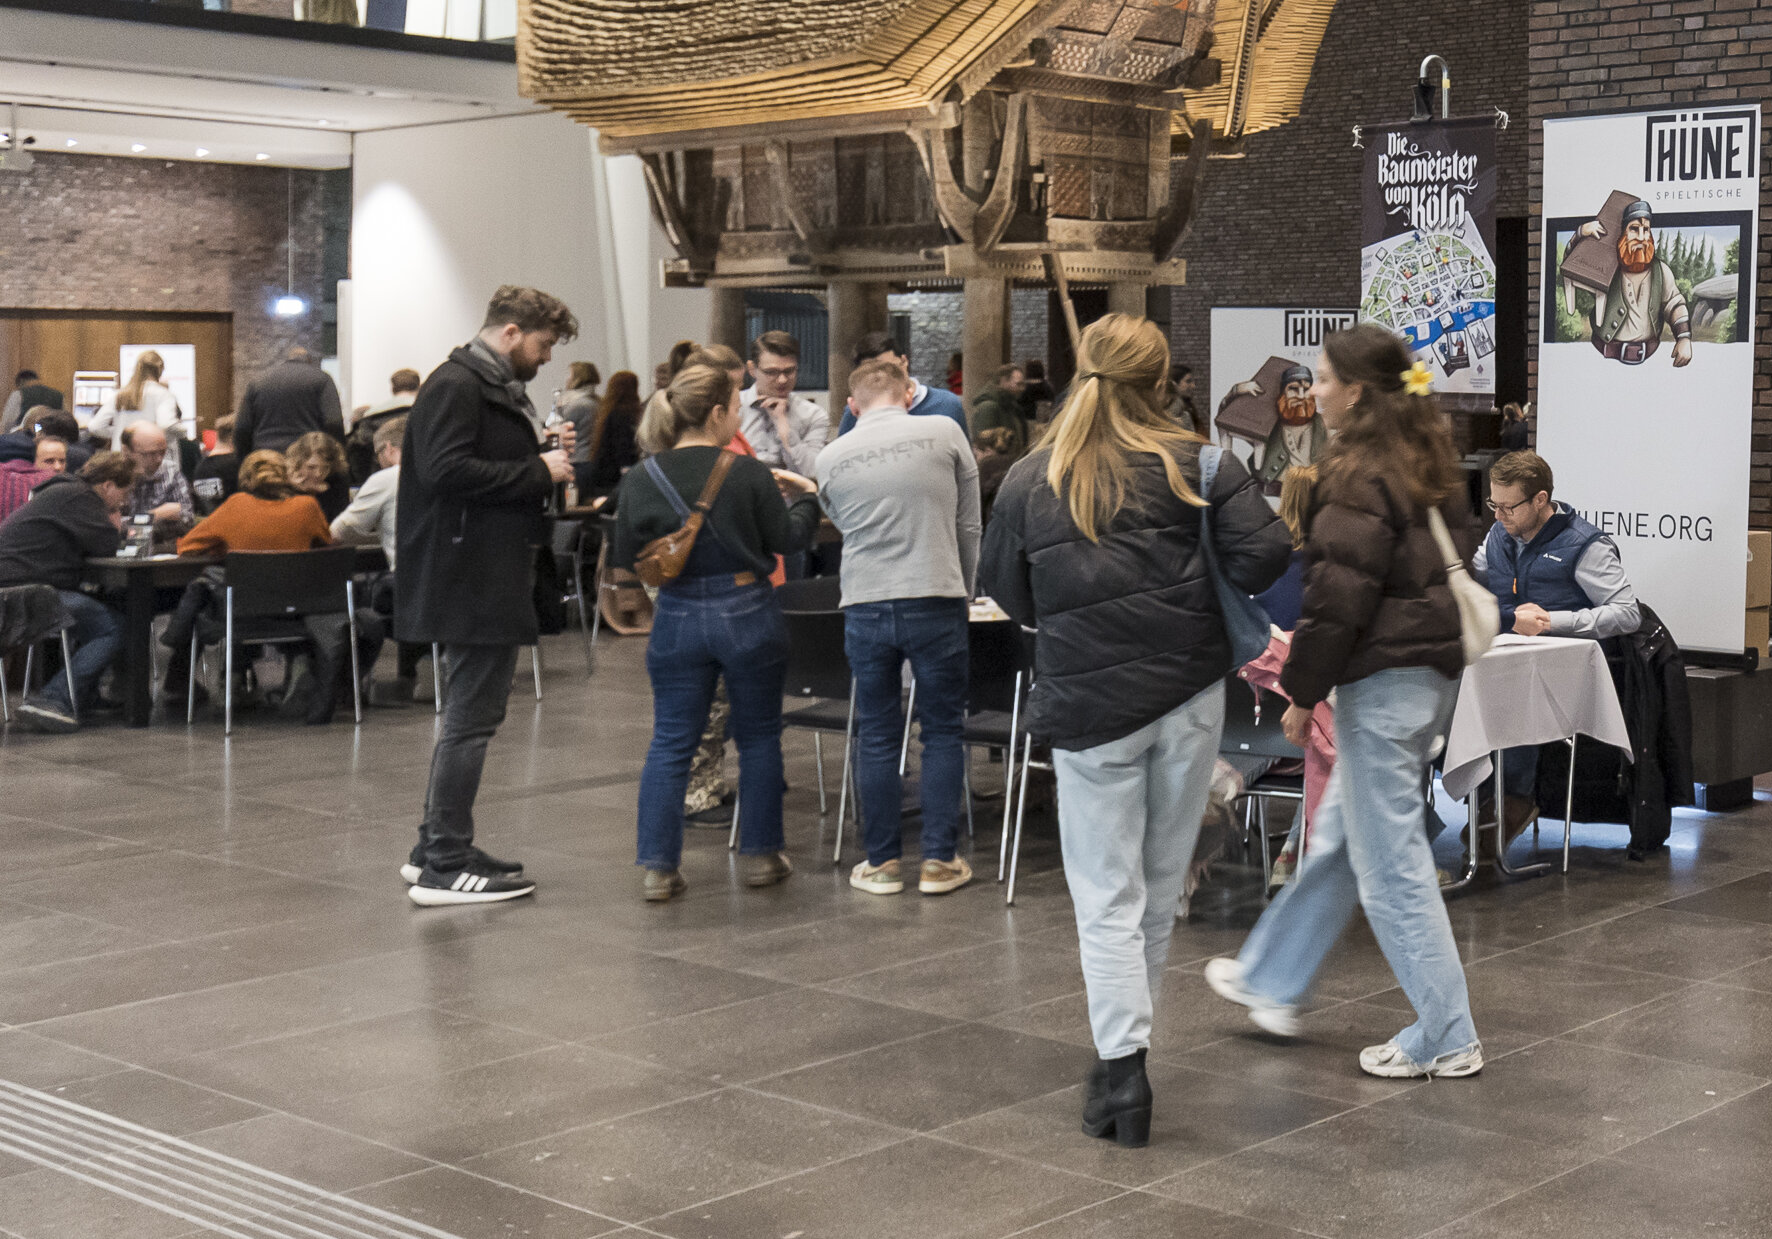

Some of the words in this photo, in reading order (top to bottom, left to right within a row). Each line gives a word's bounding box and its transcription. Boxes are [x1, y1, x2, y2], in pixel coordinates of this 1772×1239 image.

[1387, 132, 1408, 158] Die
[1657, 113, 1743, 182] HÜNE
[1378, 150, 1478, 187] Baumeister
[1385, 185, 1411, 205] von
[1411, 184, 1465, 233] Köln
[1656, 188, 1742, 200] SPIELTISCHE
